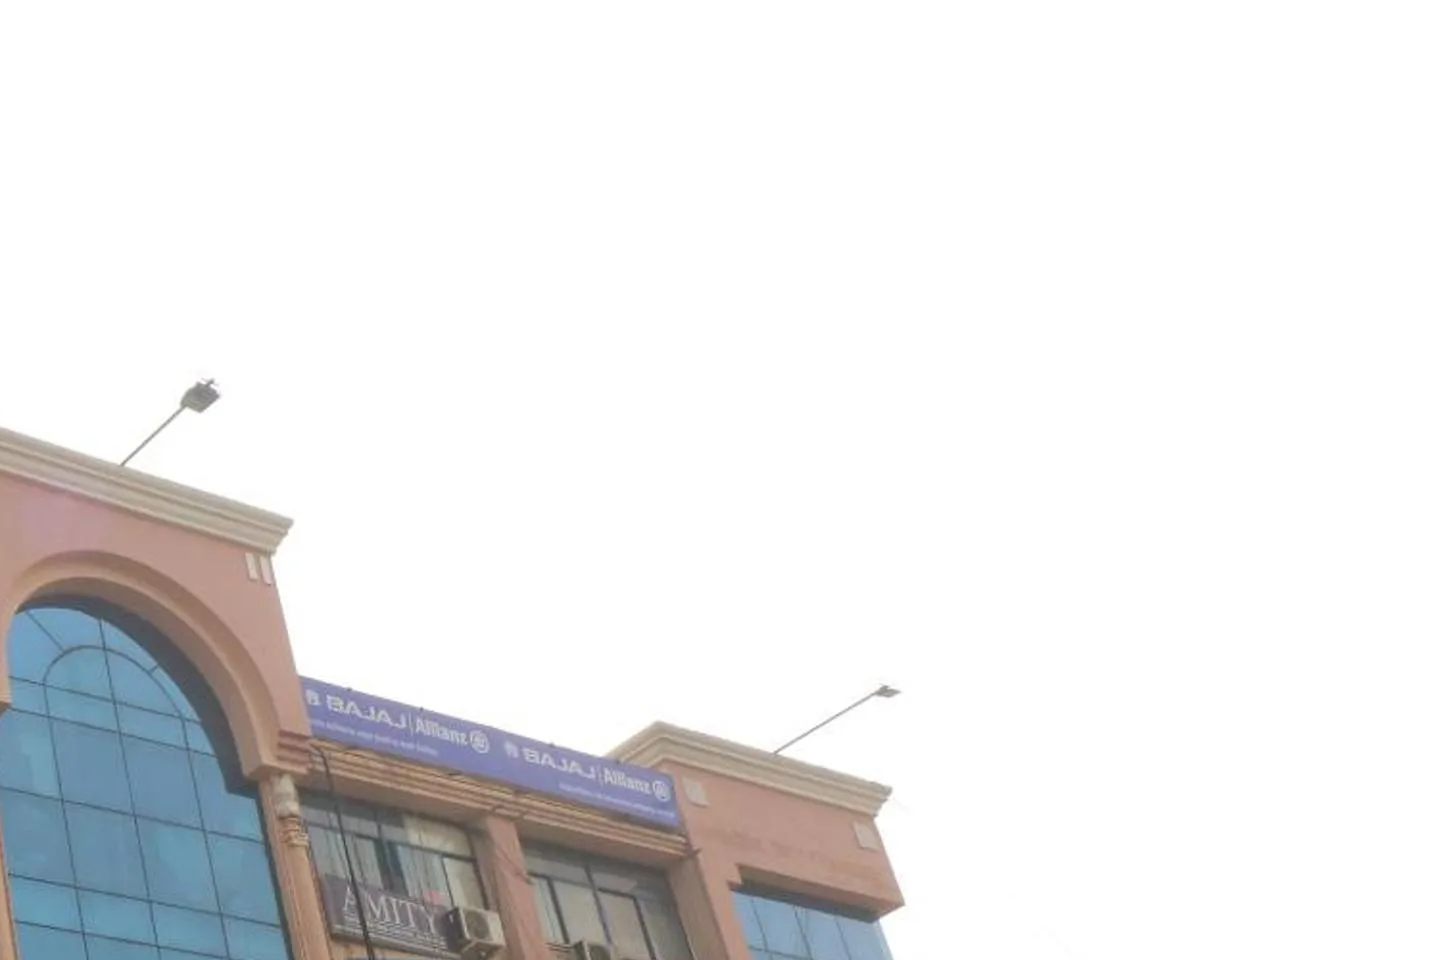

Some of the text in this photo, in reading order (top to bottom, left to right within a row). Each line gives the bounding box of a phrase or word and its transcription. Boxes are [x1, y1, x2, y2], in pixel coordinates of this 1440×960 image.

[327, 694, 407, 730] BAJAJ
[415, 717, 468, 747] Allianz
[523, 747, 653, 796] BAJAJ Allianz
[343, 885, 437, 934] AMITY
